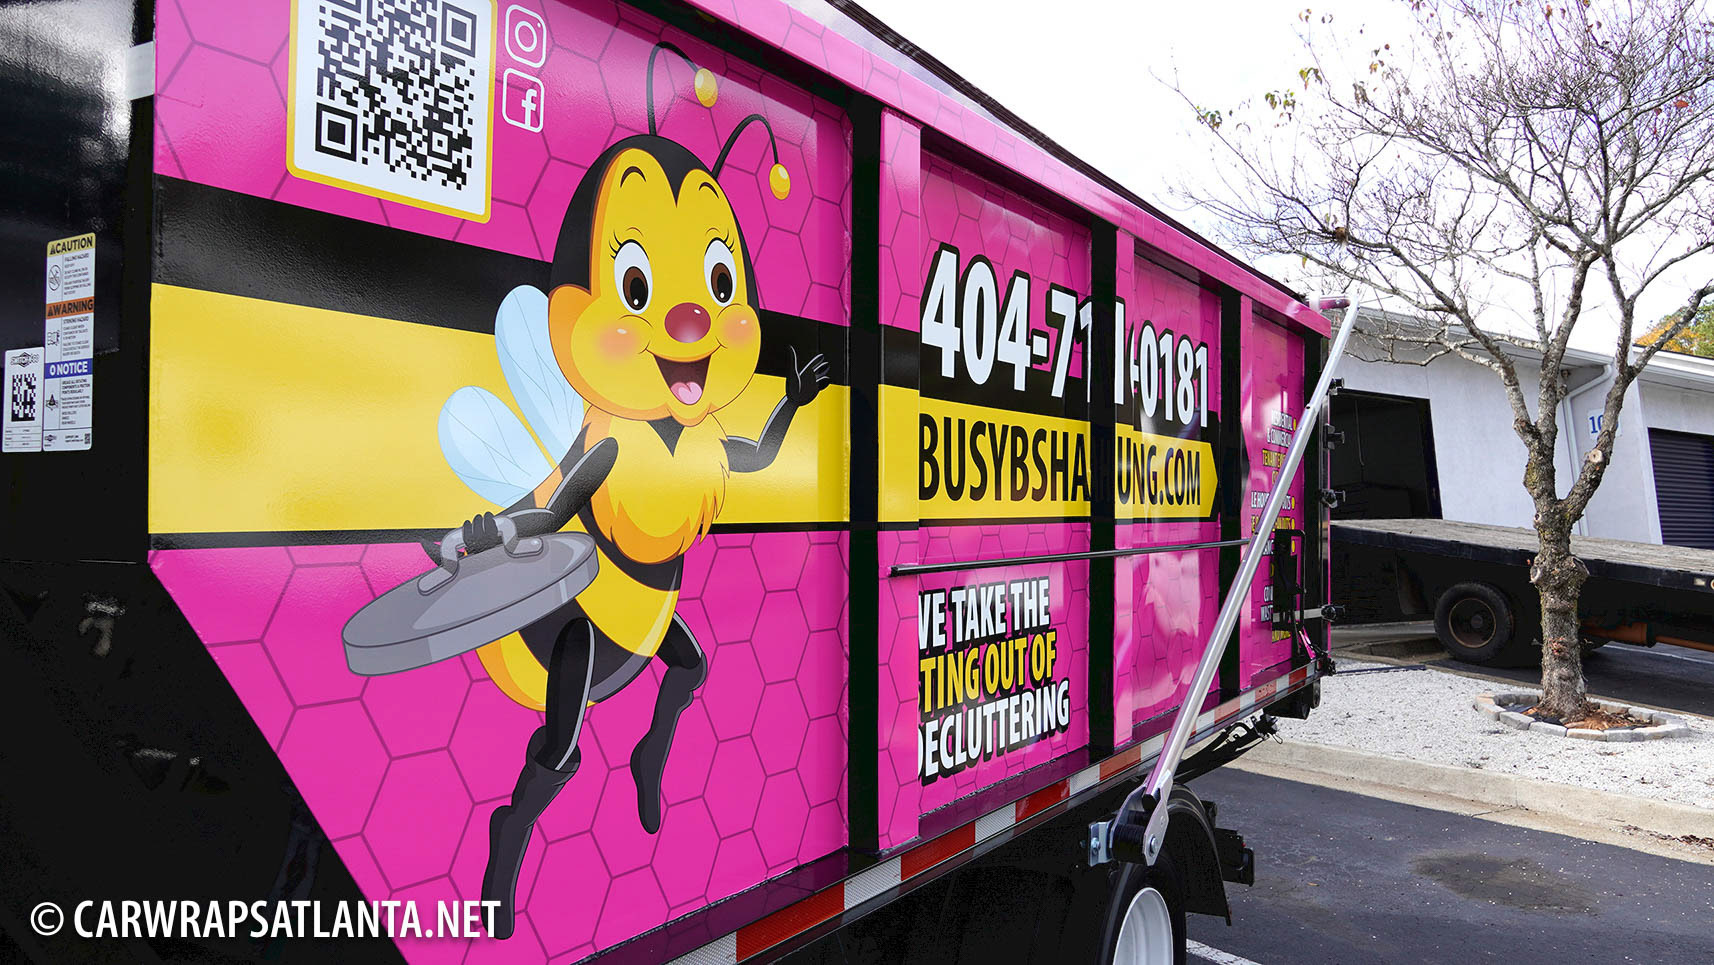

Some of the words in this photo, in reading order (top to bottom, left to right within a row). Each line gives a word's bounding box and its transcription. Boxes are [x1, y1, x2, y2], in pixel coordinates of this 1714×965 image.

[56, 236, 93, 254] CAUTION
[53, 299, 94, 316] WARNING
[57, 361, 88, 376] NOTICE
[951, 584, 1006, 642] TAKE
[1011, 578, 1050, 631] THE
[918, 647, 980, 714] TING
[985, 637, 1027, 694] OUT
[1032, 631, 1056, 681] OF
